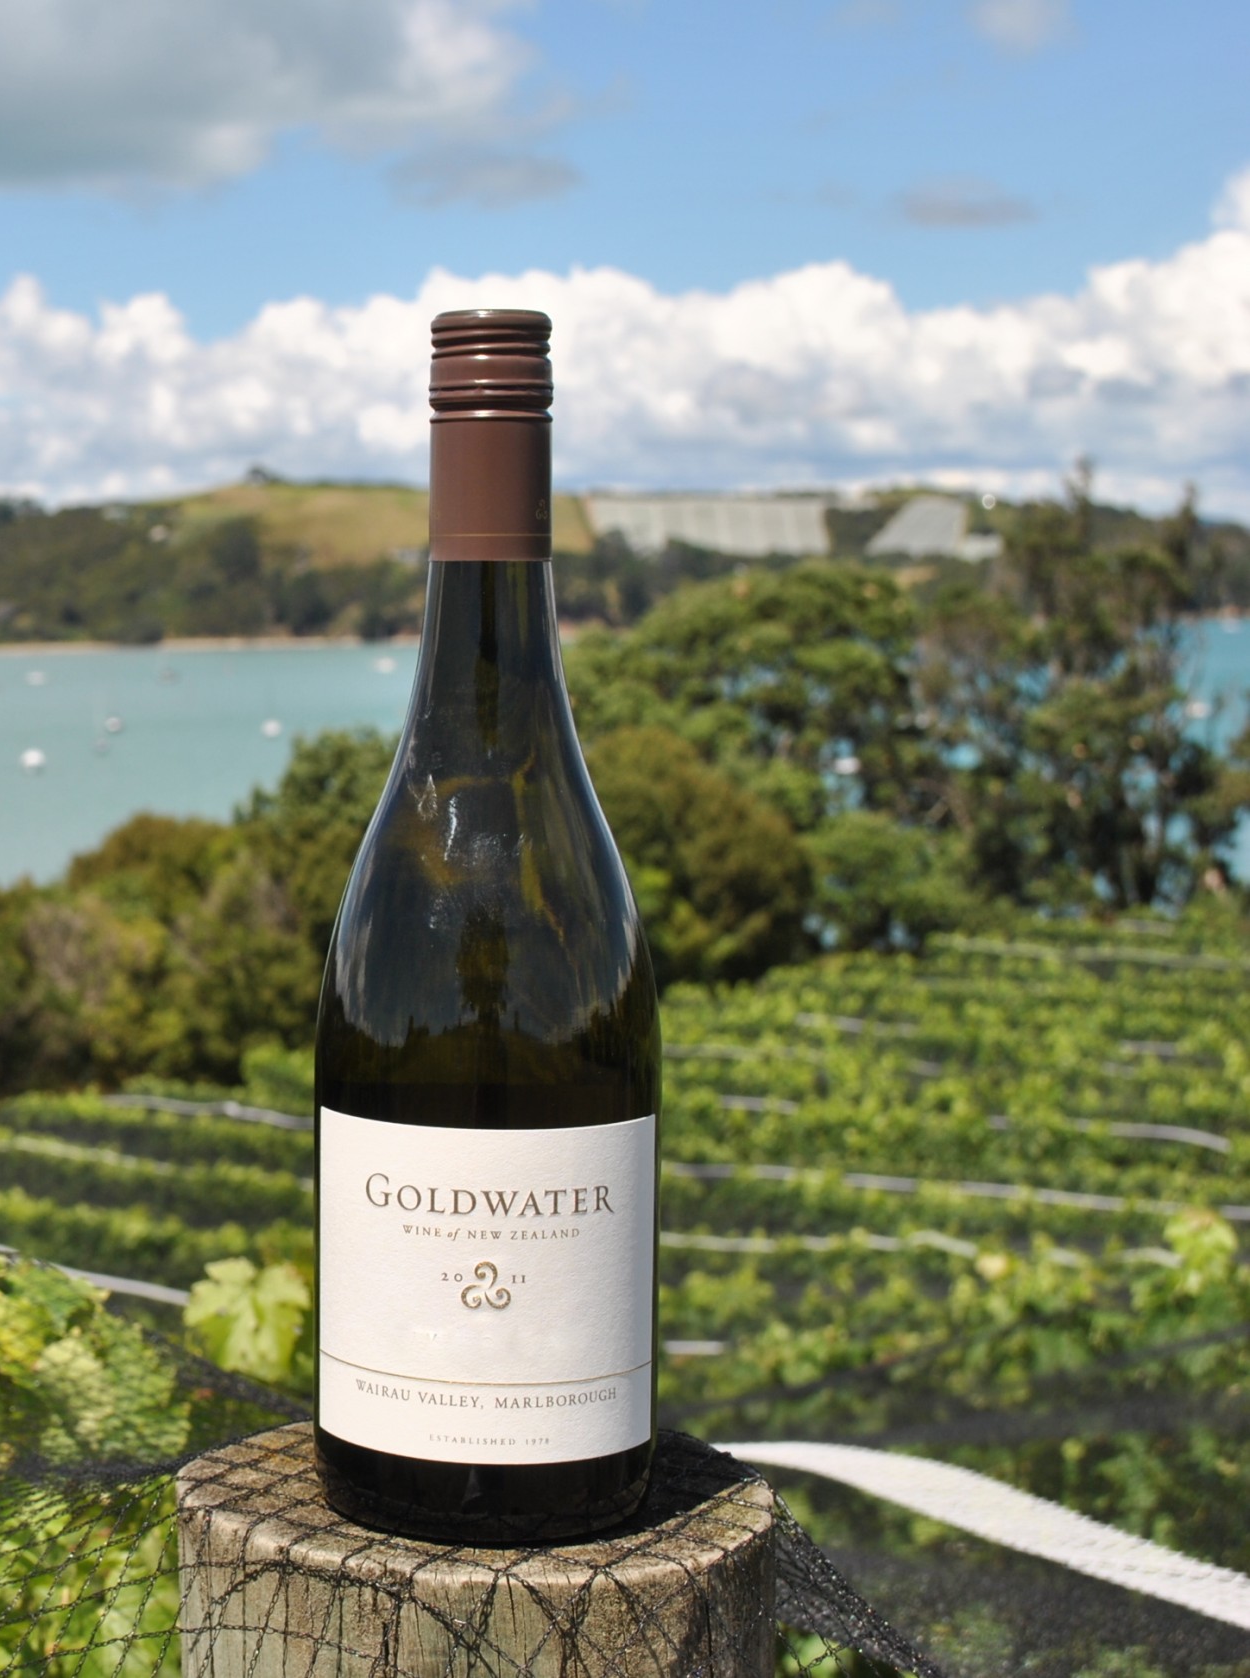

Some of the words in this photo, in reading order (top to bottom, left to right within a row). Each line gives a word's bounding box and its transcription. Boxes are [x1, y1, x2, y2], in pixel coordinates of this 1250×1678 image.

[365, 1173, 615, 1217] GOLDWATER
[402, 1224, 442, 1238] WINE
[447, 1228, 461, 1241] of
[467, 1230, 502, 1241] NEW
[510, 1227, 581, 1240] ZEALAND
[441, 1272, 463, 1282] 20
[355, 1378, 411, 1402] WAIRAU
[418, 1391, 484, 1410] VALLEY,
[494, 1387, 617, 1409] MARLBOROUGH
[429, 1433, 516, 1446] ESTABLISHED
